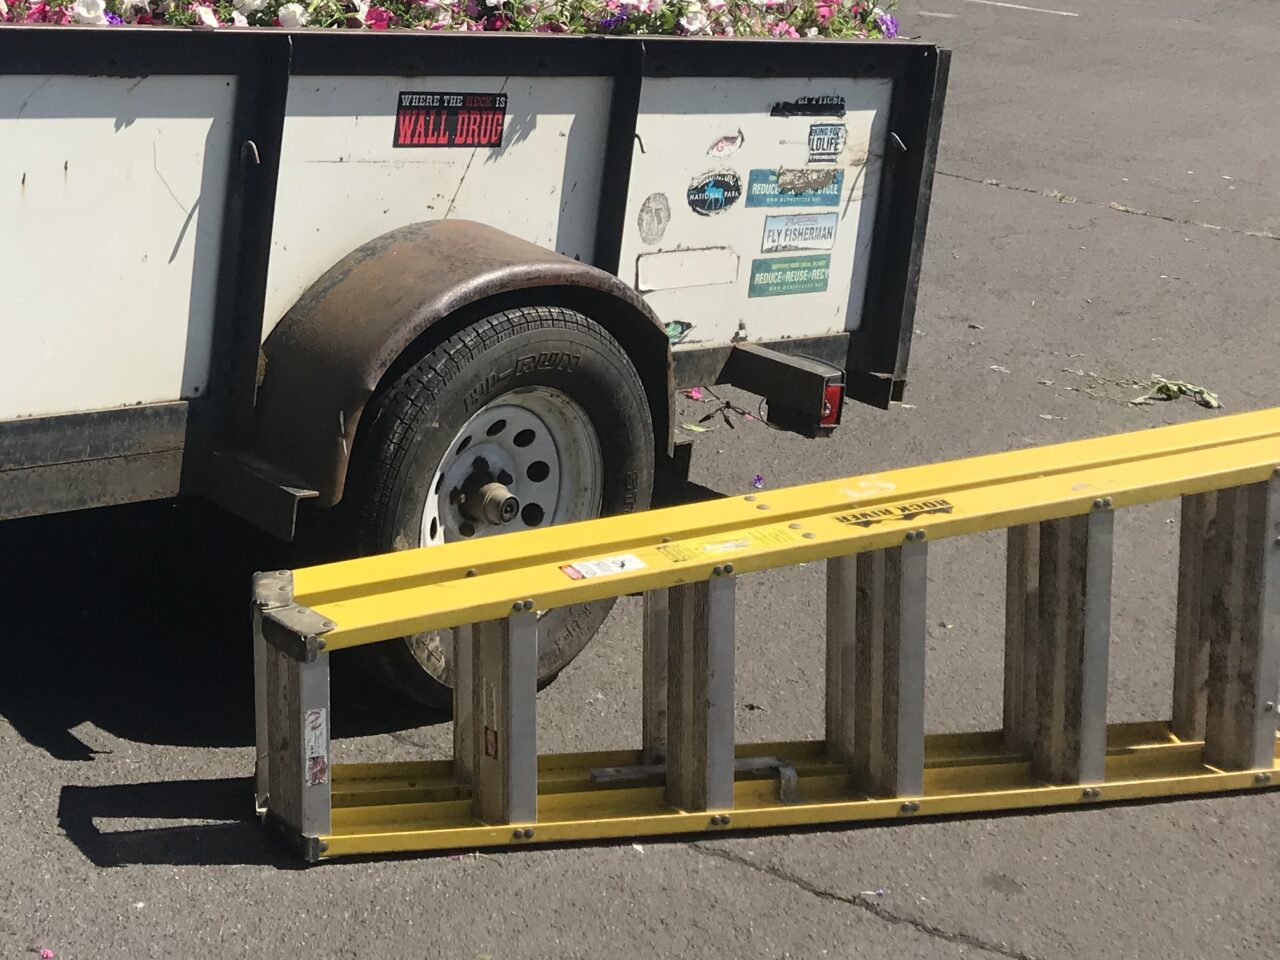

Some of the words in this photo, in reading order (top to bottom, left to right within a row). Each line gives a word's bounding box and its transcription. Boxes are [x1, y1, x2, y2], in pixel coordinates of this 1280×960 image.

[401, 95, 440, 107] WHERE
[443, 96, 464, 107] THE
[495, 97, 506, 108] IS
[398, 109, 450, 145] WALL
[454, 111, 504, 145] DRUG
[767, 229, 783, 243] FLY
[784, 226, 834, 242] FISHERMAN
[754, 271, 783, 285] REDUCE
[785, 269, 808, 282] REUSE
